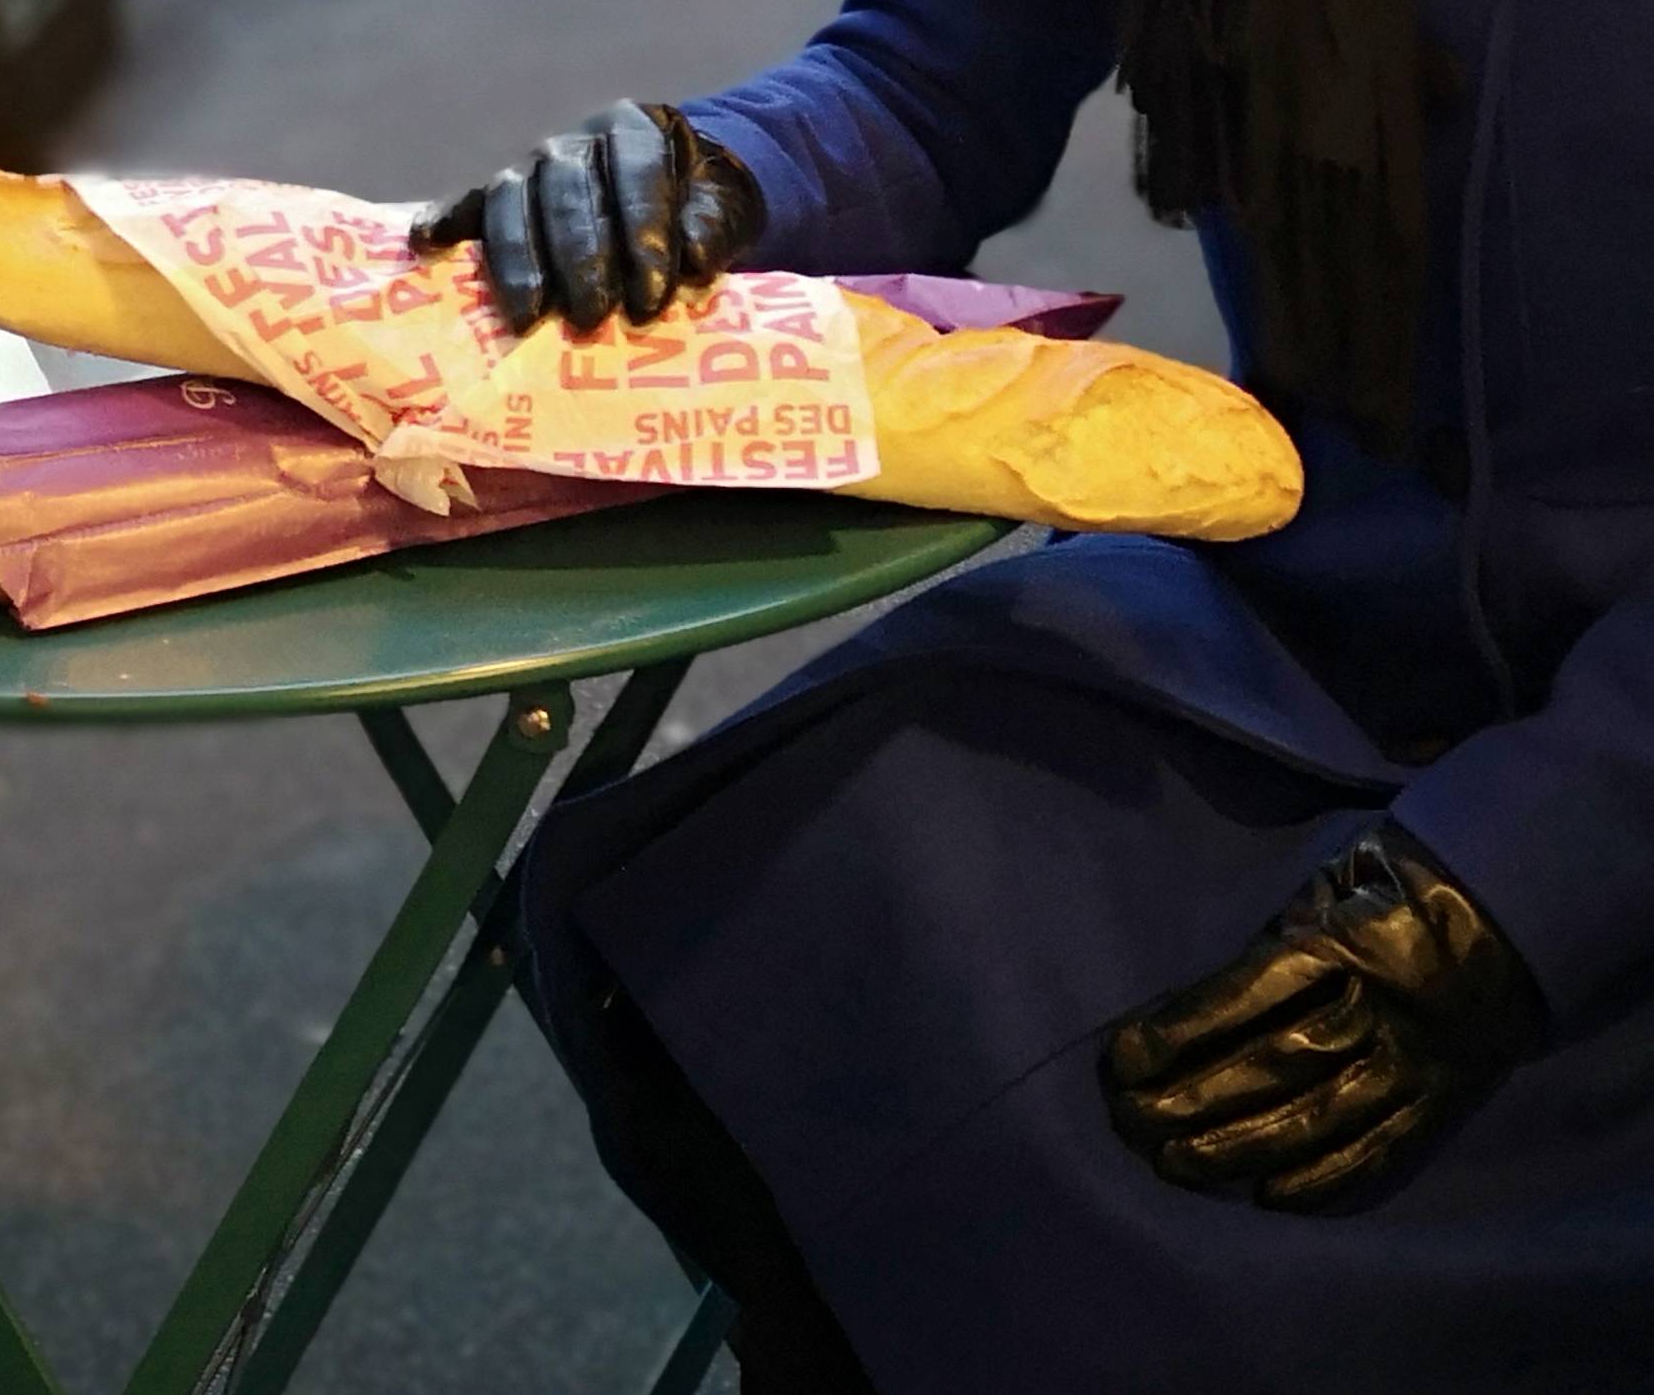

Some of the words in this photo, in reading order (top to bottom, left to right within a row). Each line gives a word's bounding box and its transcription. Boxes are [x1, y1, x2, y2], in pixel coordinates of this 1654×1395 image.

[161, 205, 292, 343] FEST
[236, 210, 326, 336] IVAL
[301, 222, 382, 326] DES
[685, 288, 761, 385] DES
[743, 272, 831, 382] PAIN
[503, 393, 534, 453] INS
[635, 407, 760, 445] PAINS
[775, 405, 853, 435] DES
